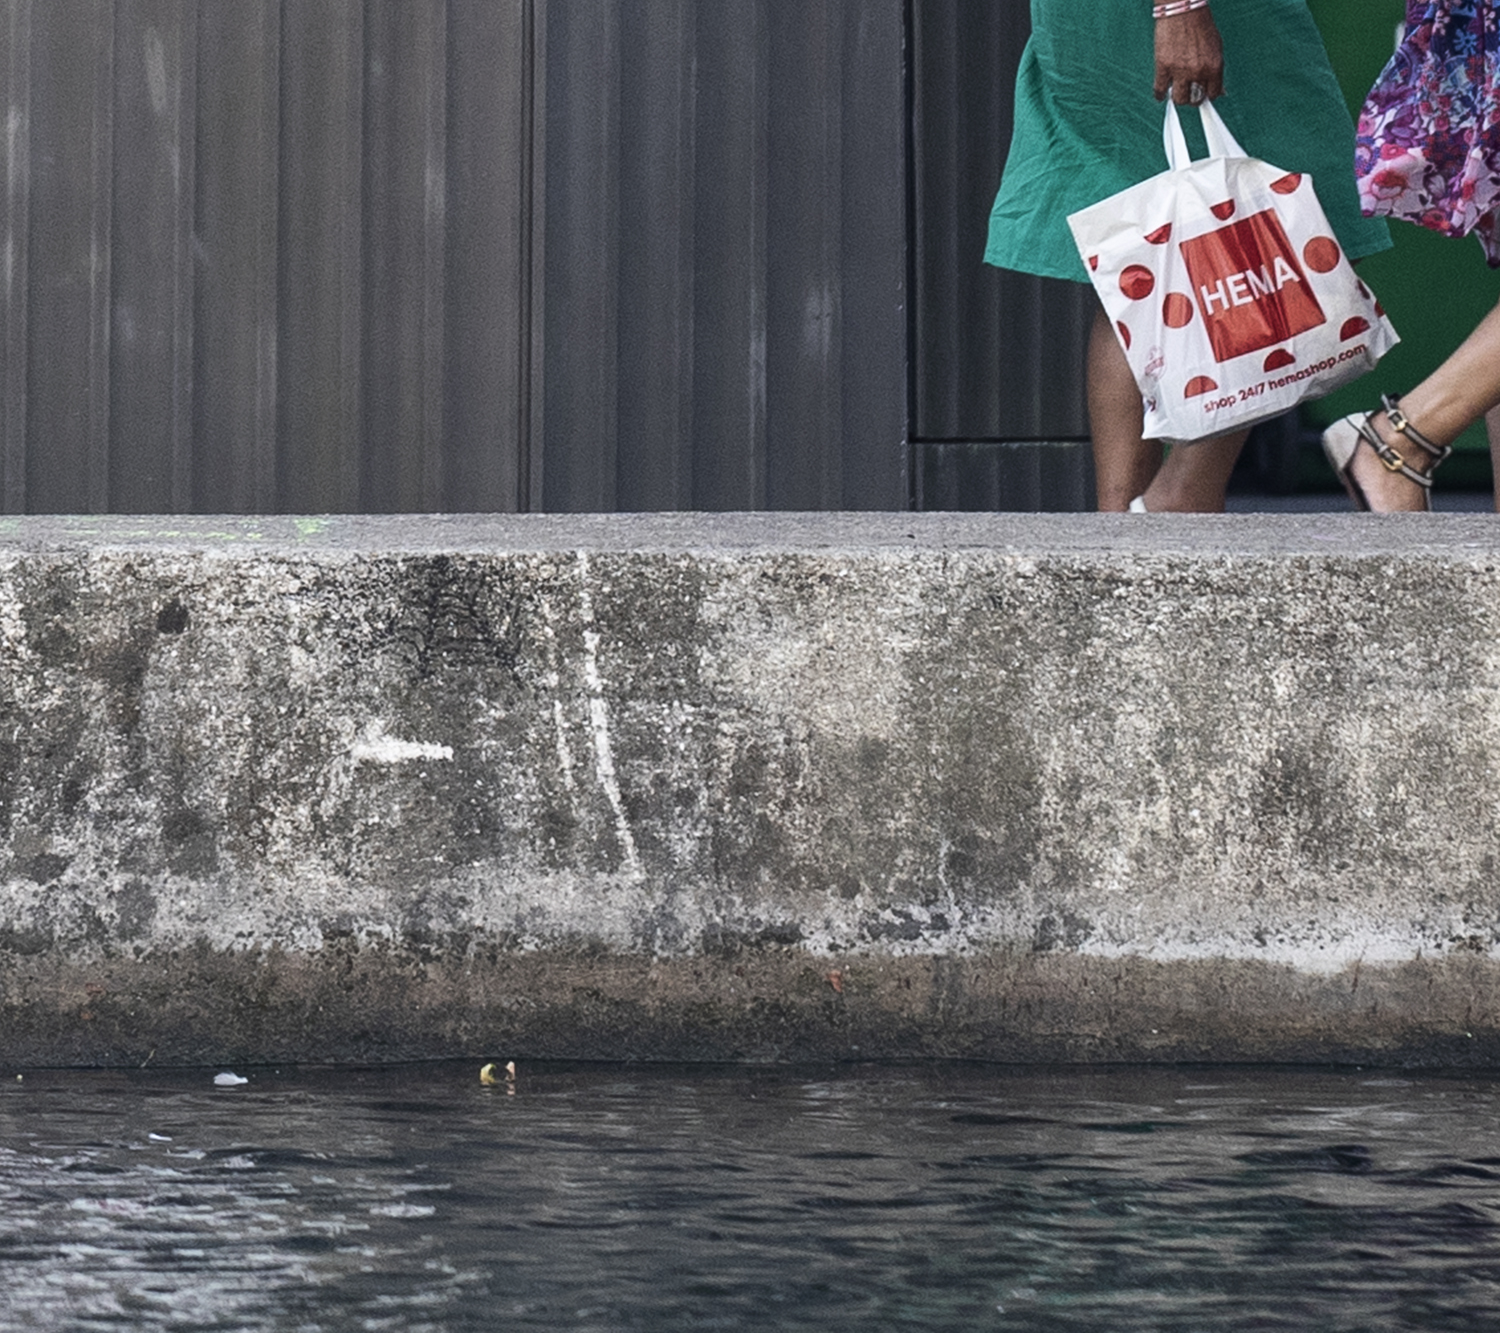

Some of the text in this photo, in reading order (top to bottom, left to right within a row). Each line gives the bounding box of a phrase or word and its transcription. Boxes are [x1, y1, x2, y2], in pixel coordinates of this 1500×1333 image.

[1200, 256, 1301, 316] HEMA
[1204, 394, 1237, 413] shop
[1269, 343, 1367, 391] hemashop.com
